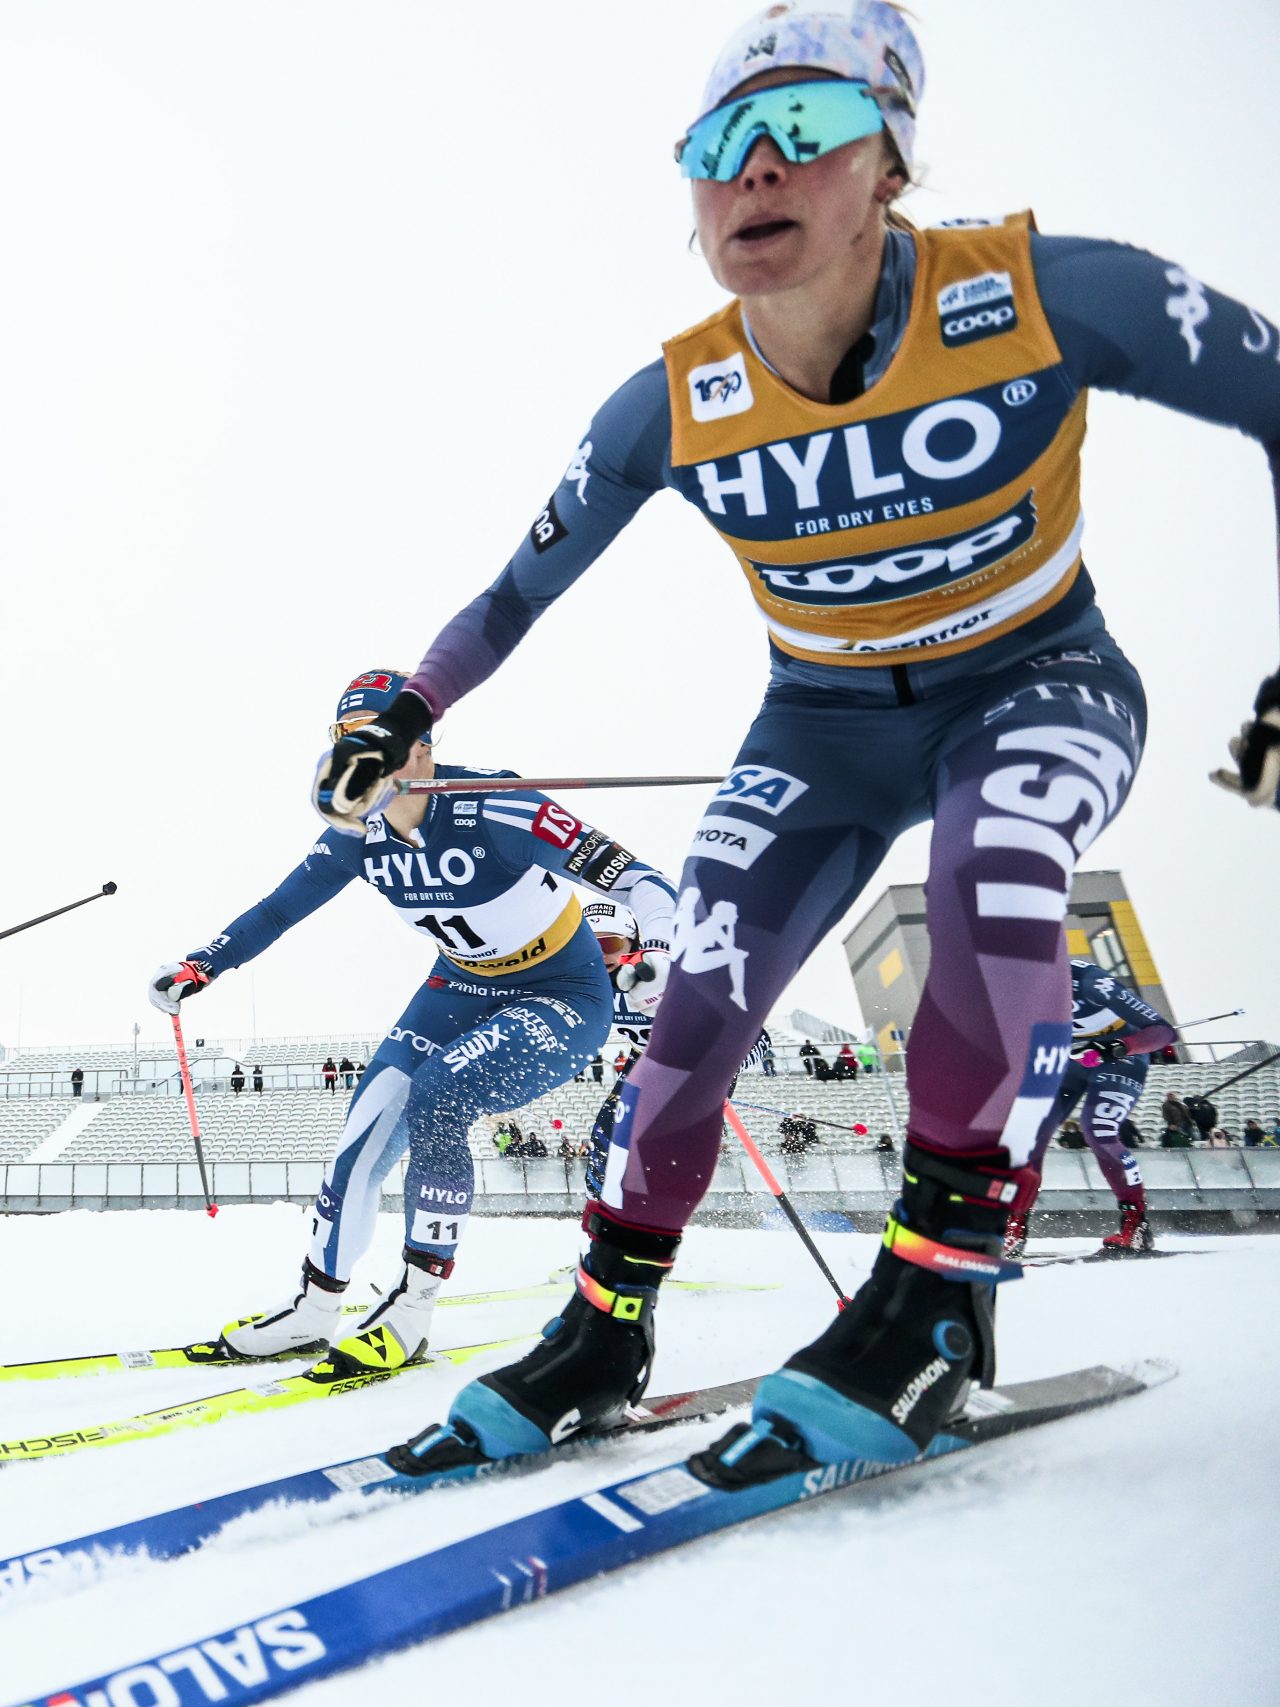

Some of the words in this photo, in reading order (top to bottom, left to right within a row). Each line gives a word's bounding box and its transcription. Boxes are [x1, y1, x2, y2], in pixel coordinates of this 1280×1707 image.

[944, 305, 1014, 336] coop
[794, 517, 833, 537] FOR
[837, 508, 875, 529] DRY
[882, 497, 935, 520] EYES
[762, 513, 1023, 593] coop
[716, 769, 792, 809] SA
[454, 818, 477, 828] coop
[974, 725, 1134, 923] USA
[404, 892, 419, 901] FOR
[420, 892, 435, 901] DRY
[436, 892, 455, 901] EYES
[414, 914, 487, 950] 11
[1033, 1045, 1071, 1075] HY
[1090, 1090, 1136, 1138] USA
[419, 1184, 469, 1205] HYLO
[426, 1220, 459, 1241] 11
[932, 1252, 1001, 1275] SALOMON
[891, 1357, 951, 1425] SALOMON
